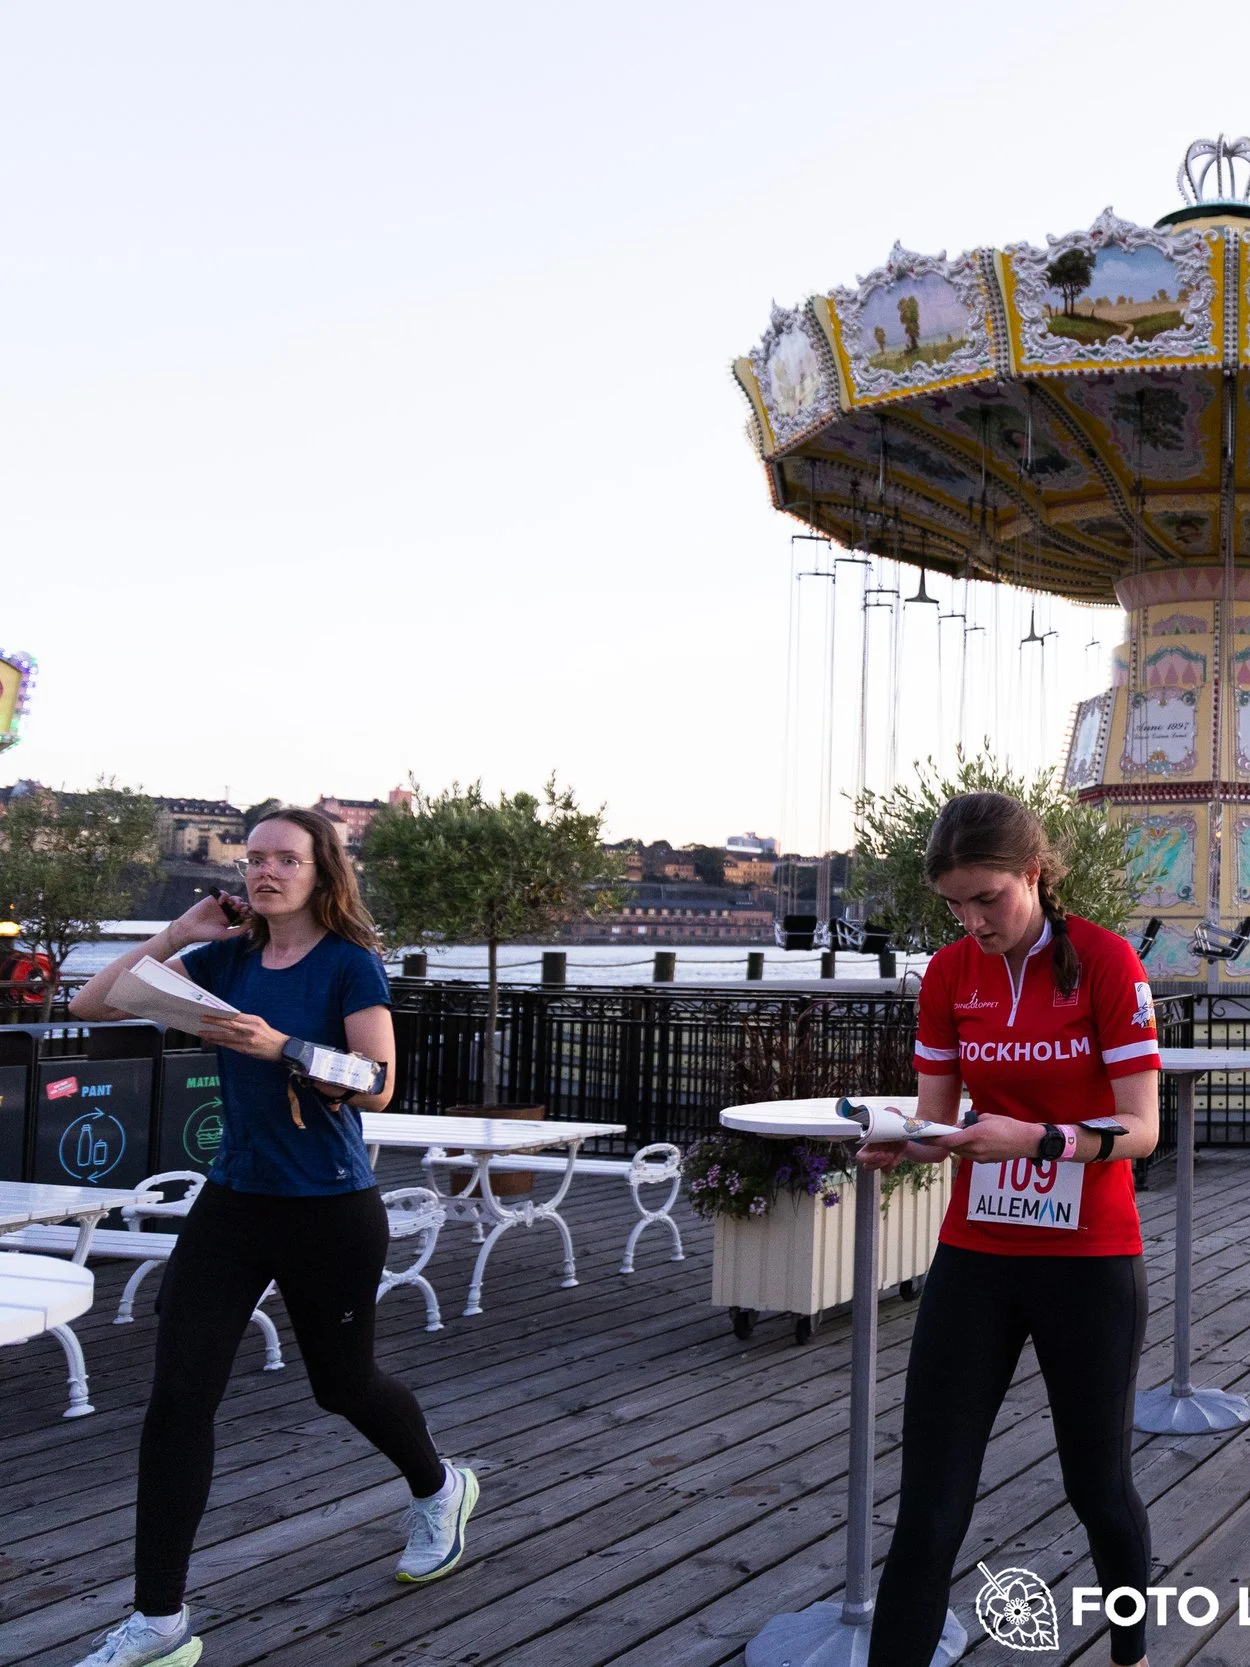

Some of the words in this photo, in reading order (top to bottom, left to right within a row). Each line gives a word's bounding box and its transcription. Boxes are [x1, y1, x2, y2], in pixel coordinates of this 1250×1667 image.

[81, 1084, 112, 1097] PANT
[998, 1156, 1058, 1194] 109
[976, 1194, 1072, 1226] ALLEMAN
